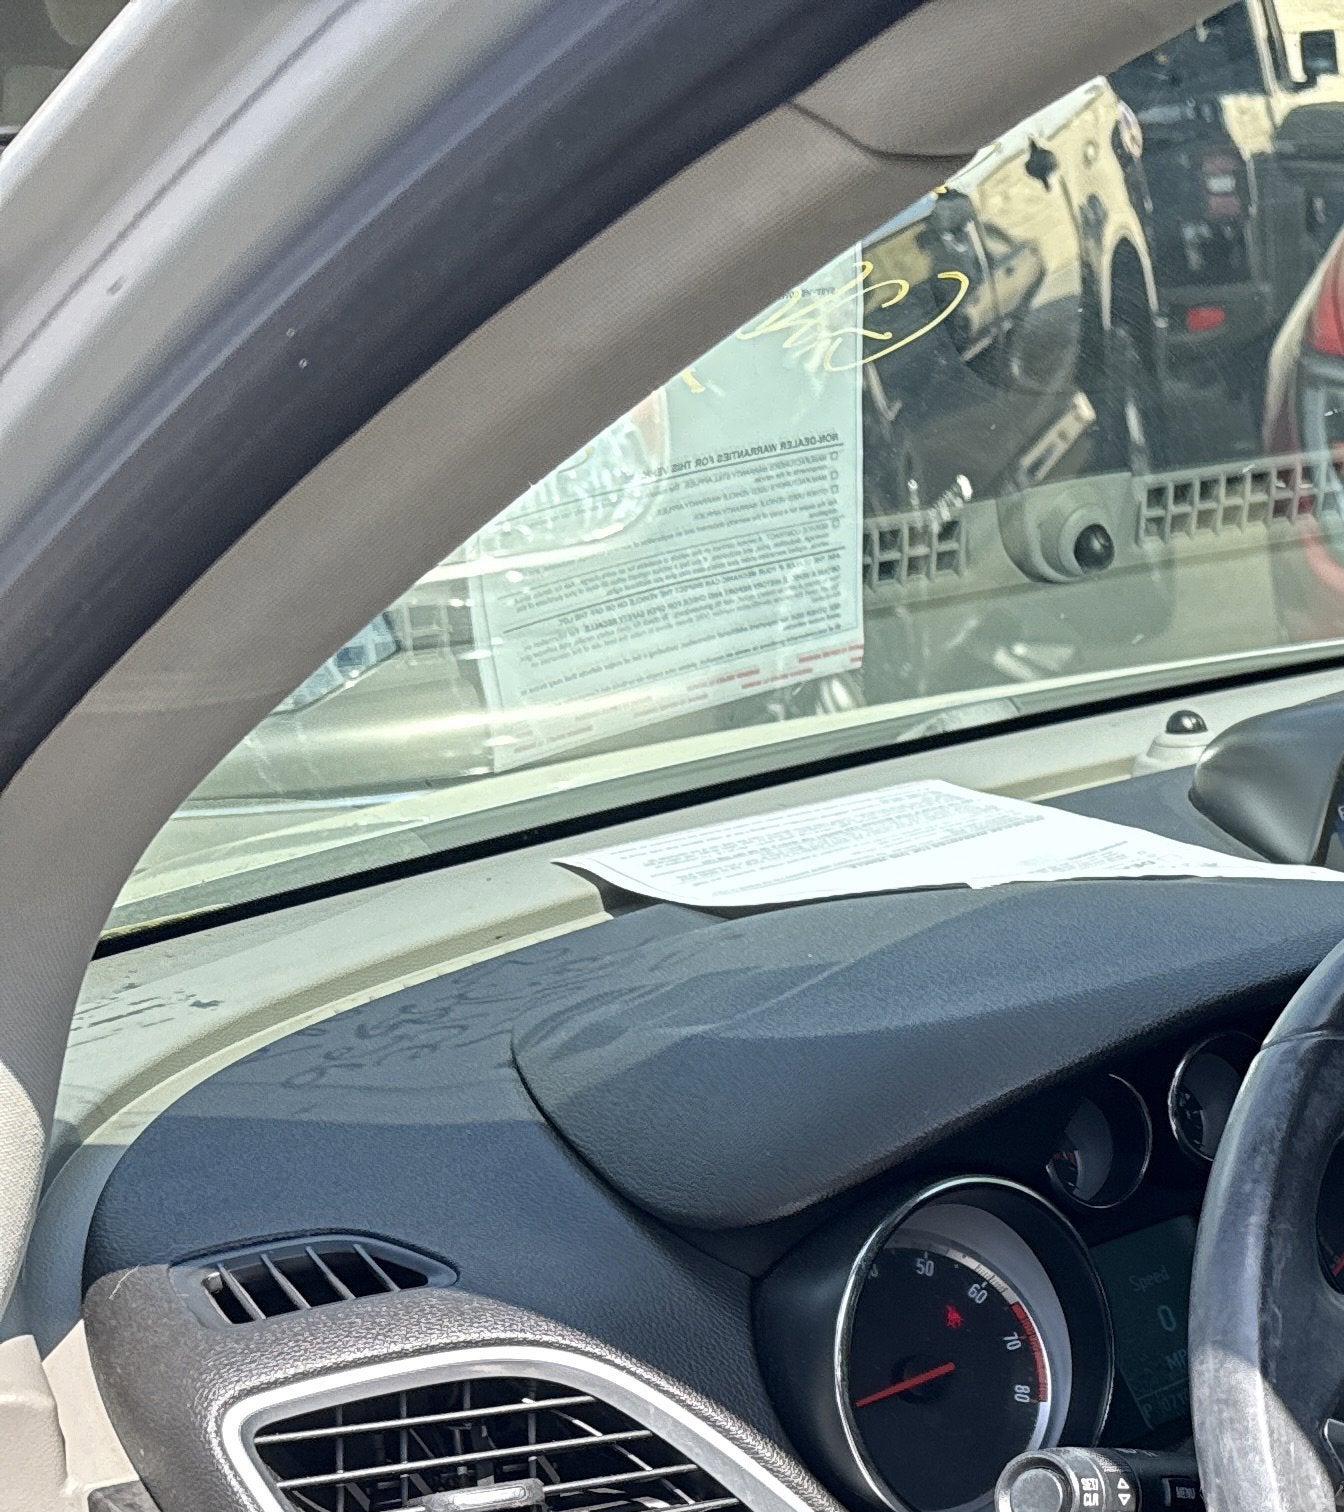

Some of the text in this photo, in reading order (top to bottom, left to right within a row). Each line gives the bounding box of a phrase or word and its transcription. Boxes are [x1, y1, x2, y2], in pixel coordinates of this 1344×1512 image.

[916, 1257, 935, 1277] 50
[1128, 1264, 1171, 1293] Speed
[967, 1283, 988, 1304] 60
[1157, 1304, 1177, 1332] 0
[1001, 1331, 1022, 1351] 70
[1165, 1348, 1187, 1371] MP
[1014, 1384, 1031, 1403] 80
